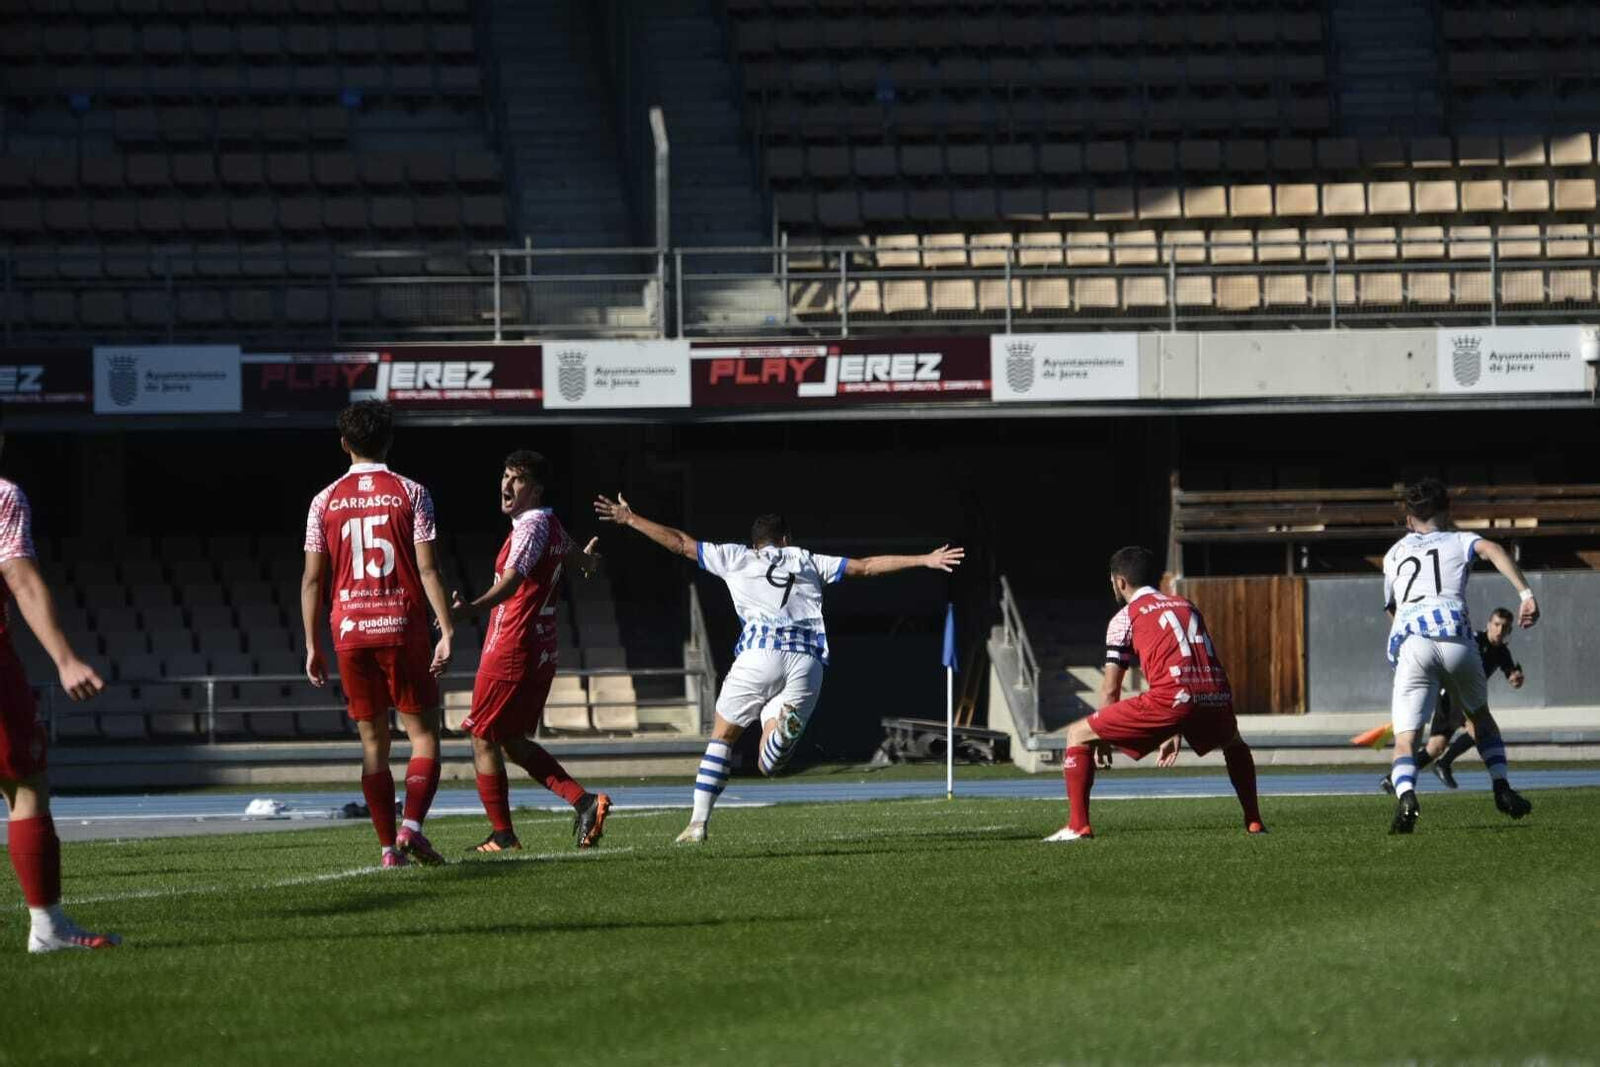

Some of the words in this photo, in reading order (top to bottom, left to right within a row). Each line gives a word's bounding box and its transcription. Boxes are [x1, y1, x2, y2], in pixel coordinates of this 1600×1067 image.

[1043, 358, 1124, 368] Ayuntamiento
[1488, 351, 1571, 362] Ayuntamiento
[145, 370, 227, 381] Ayuntamiento
[594, 366, 676, 376] Ayuntamiento
[710, 358, 816, 385] PLAY
[797, 346, 942, 397] JEREZ
[1043, 371, 1056, 379] de
[1059, 371, 1089, 381] Jerez
[1489, 363, 1502, 372] de
[1506, 363, 1535, 374] Jerez
[262, 362, 368, 390] PLAY
[349, 352, 494, 402] JEREZ
[594, 378, 608, 387] de
[610, 378, 640, 390] Jerez
[329, 494, 403, 511] CARRASCO
[341, 514, 395, 579] 15
[766, 556, 796, 610] 9
[1396, 548, 1442, 605] 21
[358, 616, 410, 632] guadalete
[1158, 610, 1214, 657] 14
